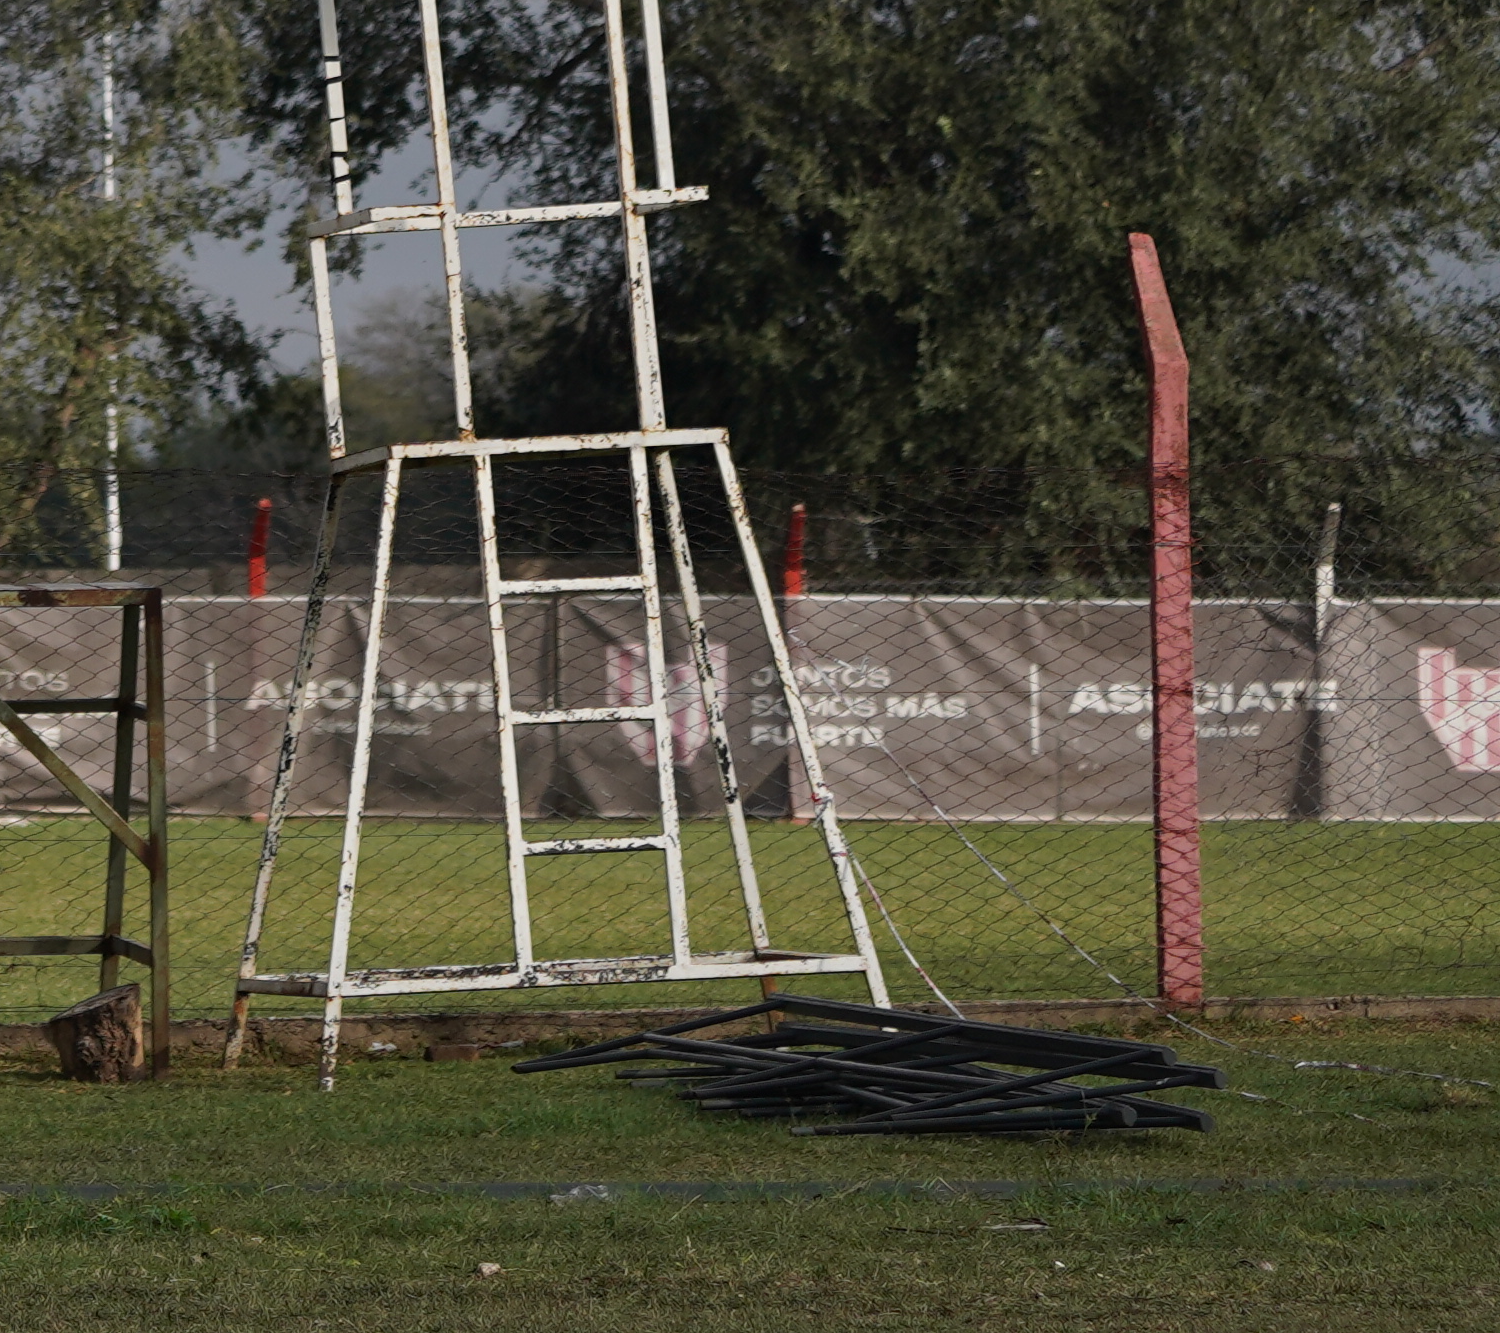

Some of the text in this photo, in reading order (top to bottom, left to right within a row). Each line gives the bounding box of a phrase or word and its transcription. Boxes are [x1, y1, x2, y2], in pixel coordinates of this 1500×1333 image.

[751, 666, 891, 688] JNTOS
[1067, 683, 1338, 714] ASCIATE
[751, 724, 885, 747] FURTE
